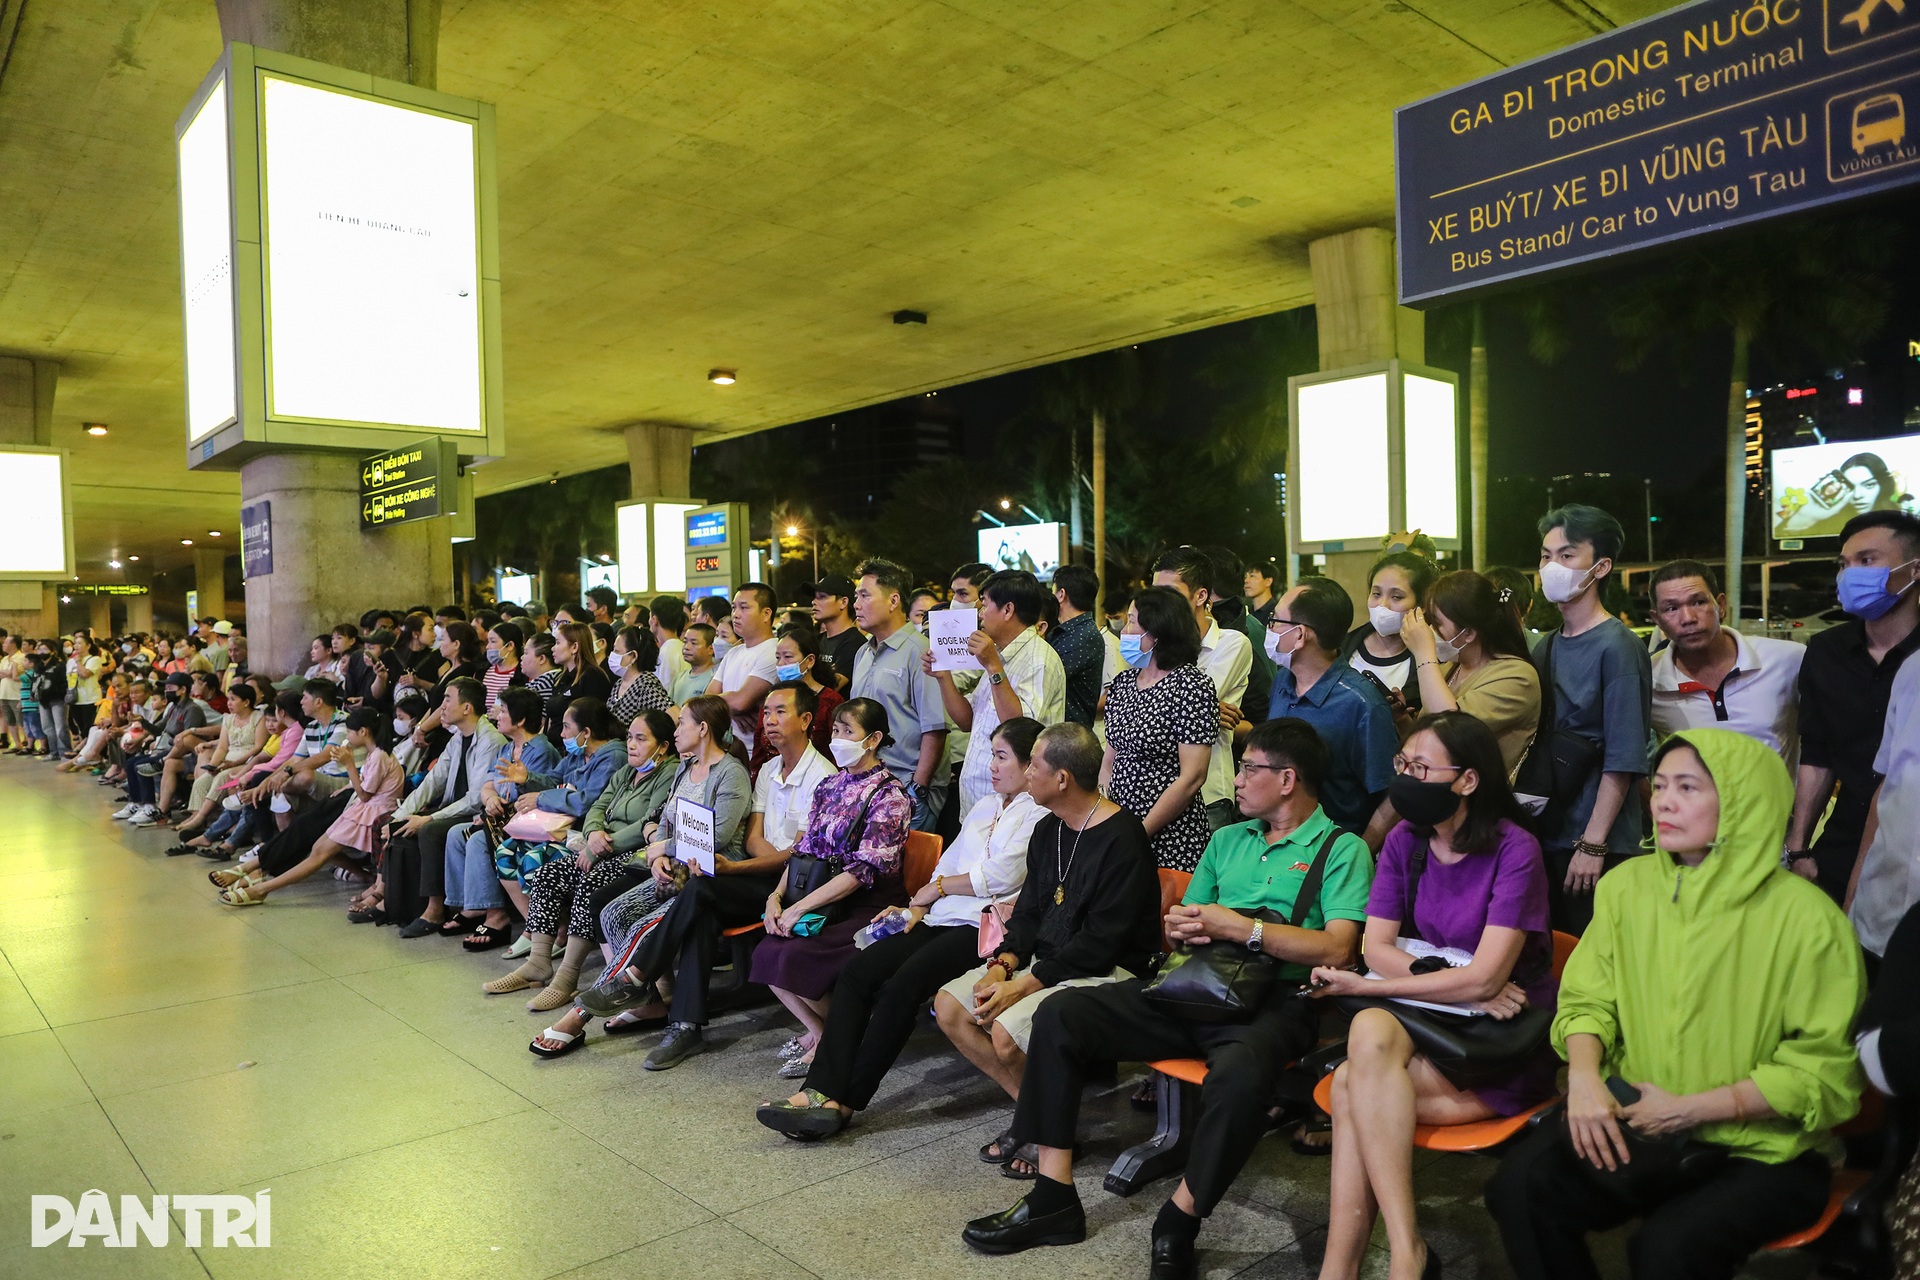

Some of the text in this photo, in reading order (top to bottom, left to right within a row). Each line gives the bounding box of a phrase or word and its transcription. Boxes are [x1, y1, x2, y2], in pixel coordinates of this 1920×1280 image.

[1450, 0, 1801, 136] GA ĐI TRONG NƯỚC
[1548, 38, 1804, 140] Domestic Terminal
[1428, 112, 1808, 245] XE BUÝT/ XE ĐI VŨNG TÀU
[1450, 165, 1806, 273] Bus Stand/ Car to Vung Tau
[409, 450, 422, 463] TAXI
[937, 636, 958, 646] BOGIE
[682, 811, 709, 835] Welcome
